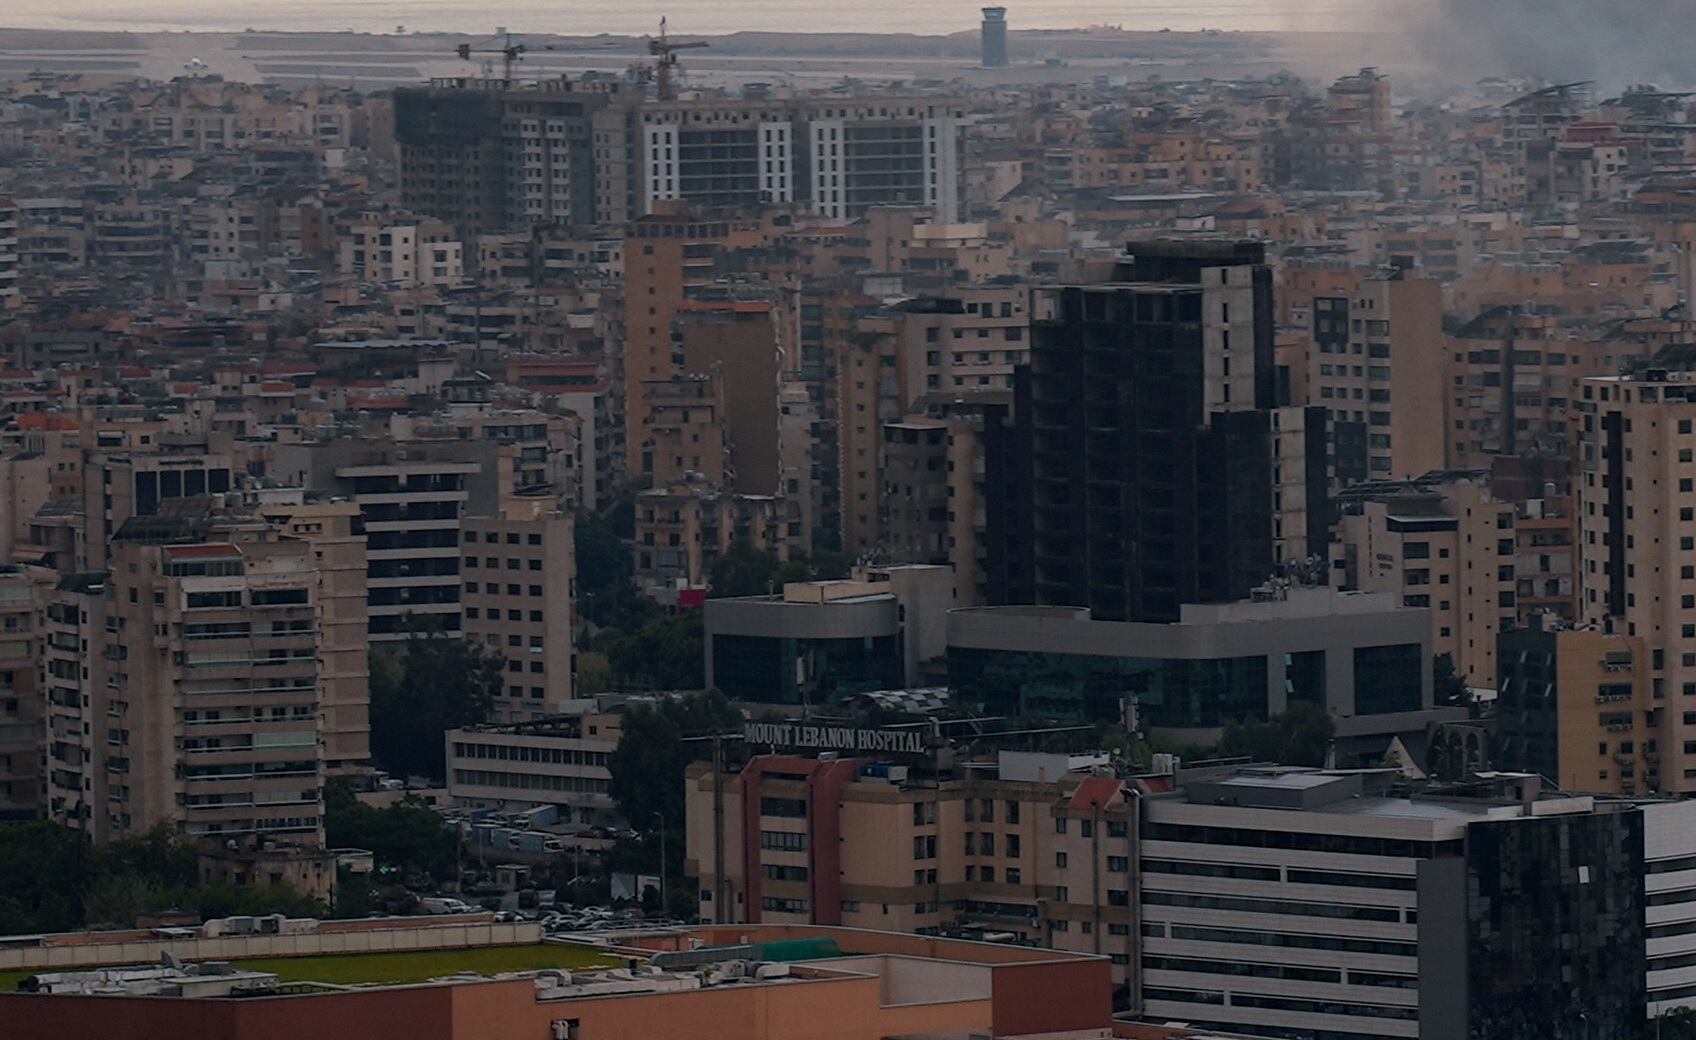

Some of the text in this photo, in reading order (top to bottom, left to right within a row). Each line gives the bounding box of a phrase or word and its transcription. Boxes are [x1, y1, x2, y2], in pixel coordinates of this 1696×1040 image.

[744, 723, 925, 753] MOUNT LEBANON HOSPITAL
